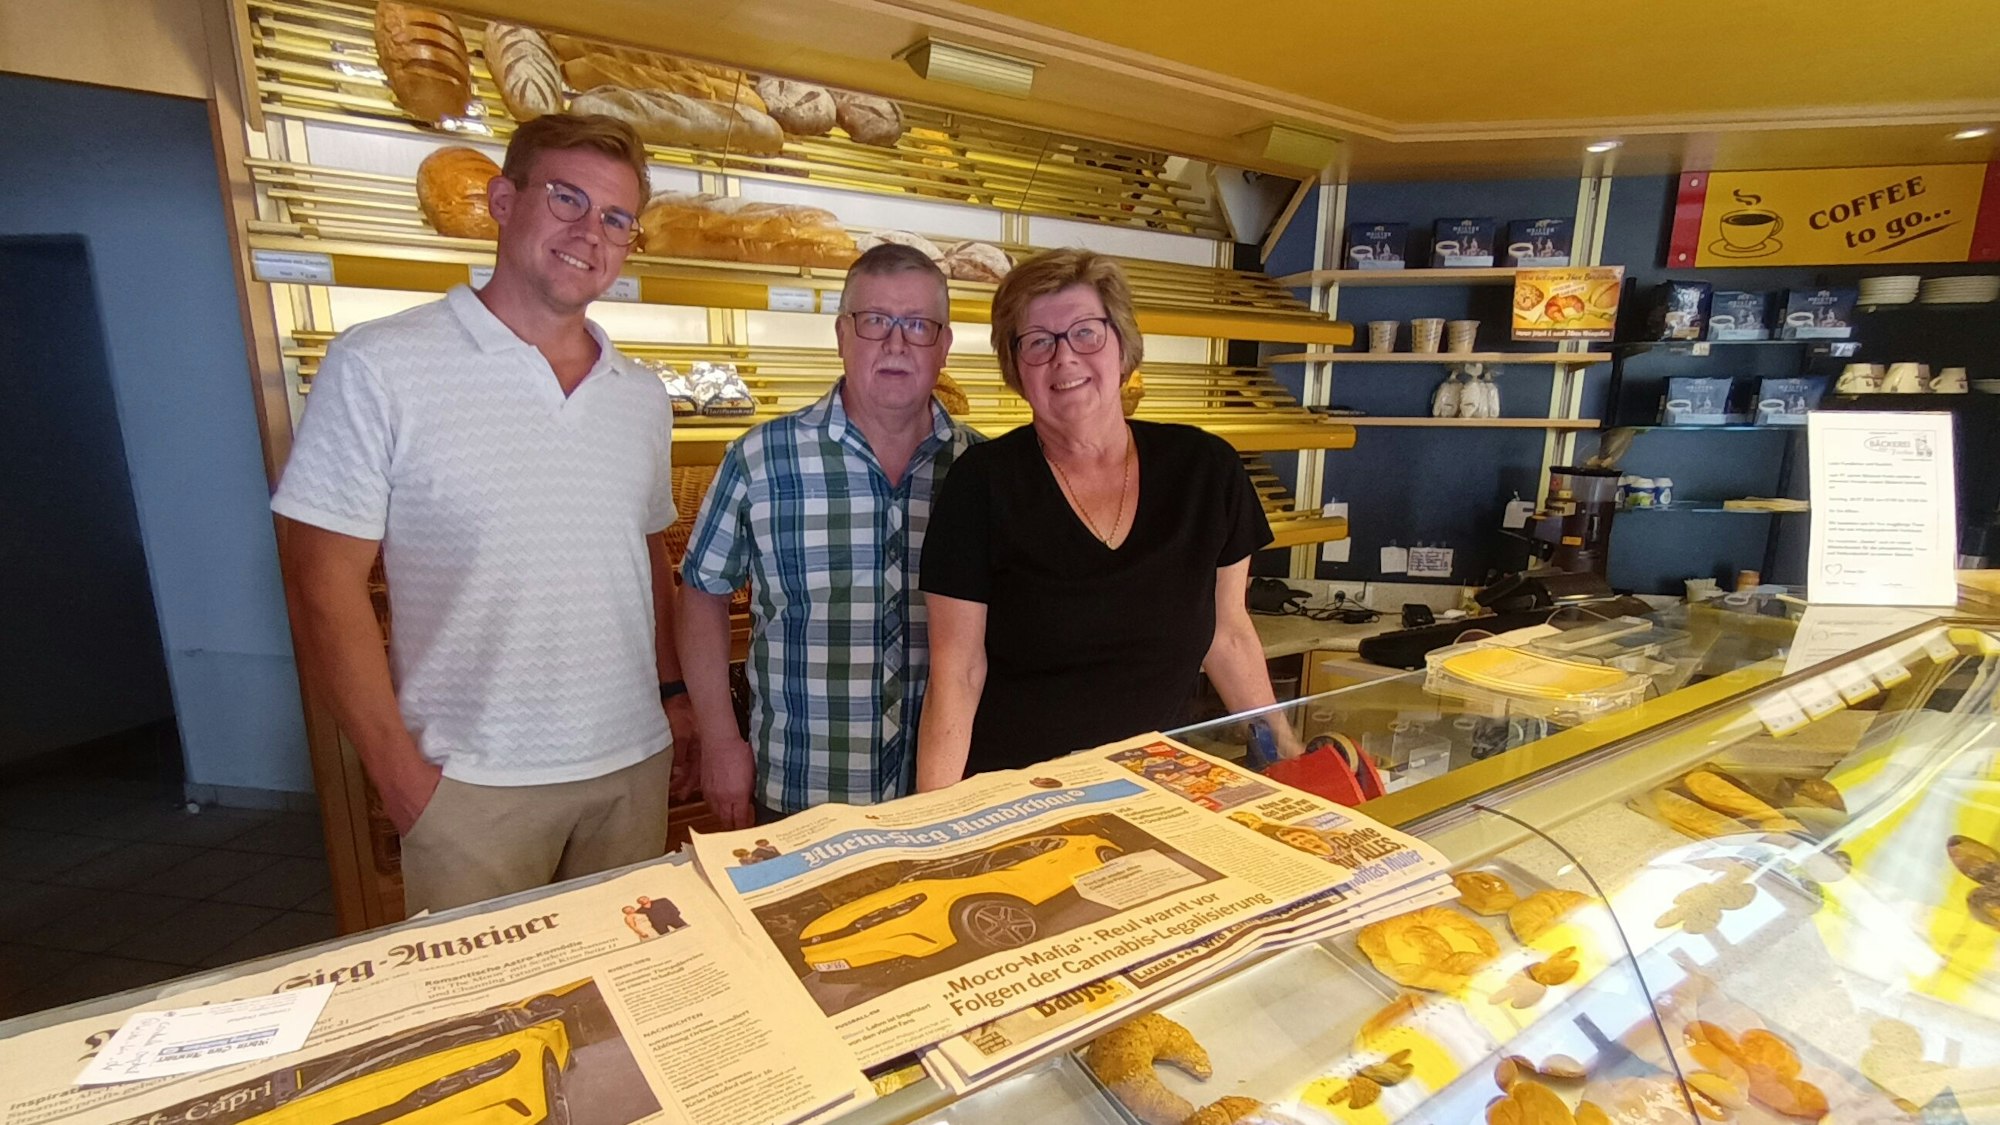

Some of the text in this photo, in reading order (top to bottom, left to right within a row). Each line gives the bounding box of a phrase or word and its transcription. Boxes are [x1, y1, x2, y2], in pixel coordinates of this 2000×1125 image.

[1808, 176, 1926, 230] COFFEE
[1845, 209, 1951, 248] to go...
[1330, 827, 1381, 850] Danke
[1095, 917, 1143, 945] Reul
[1142, 902, 1194, 930] warnt
[1195, 891, 1221, 908] vor
[949, 978, 1028, 1019] Folgen
[1027, 961, 1064, 989] der
[1065, 891, 1273, 975] Cannabis-Legalisierung
[1134, 957, 1175, 981] Luxus
[425, 965, 501, 987] Romantische
[643, 1012, 703, 1038] NACHRICHTEN
